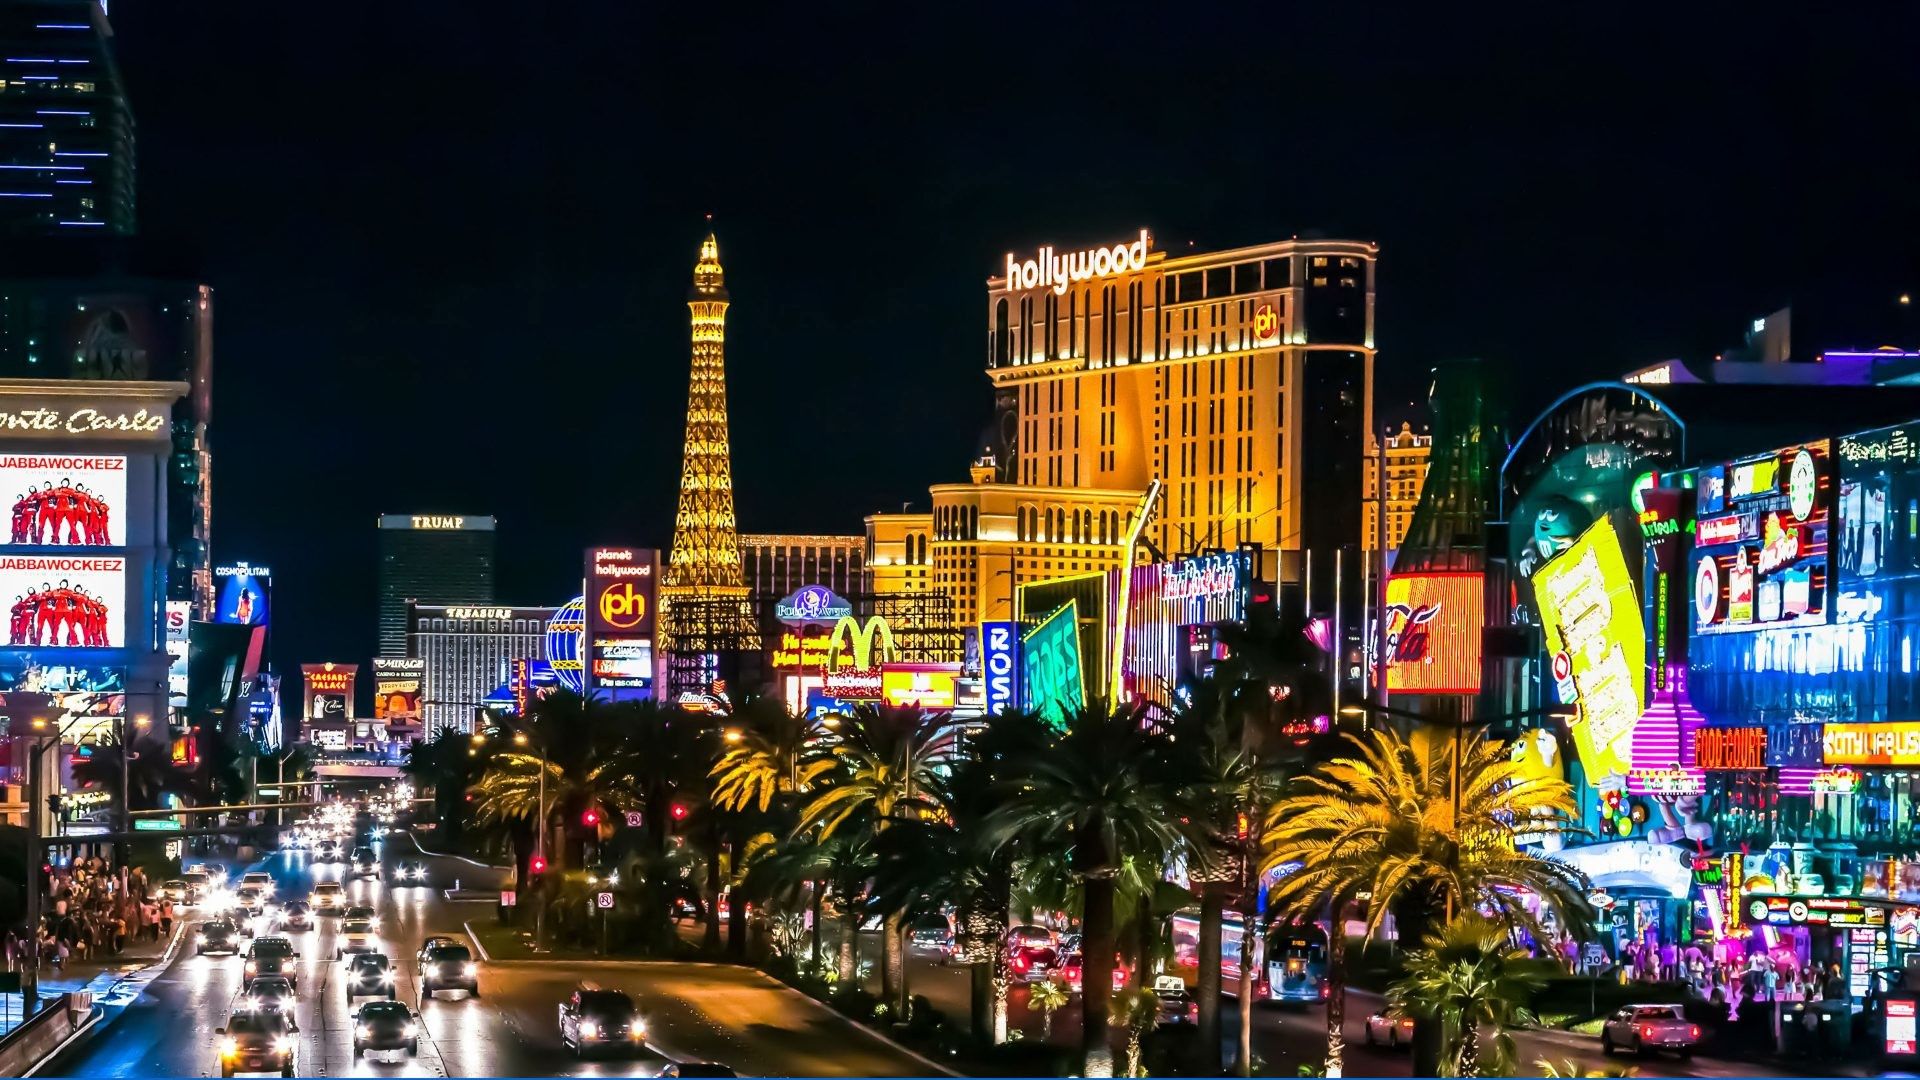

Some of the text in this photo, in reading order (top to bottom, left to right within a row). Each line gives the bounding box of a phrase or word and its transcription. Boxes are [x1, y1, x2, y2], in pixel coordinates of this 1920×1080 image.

[1006, 229, 1148, 295] hollywood
[1255, 306, 1277, 332] ph
[66, 408, 164, 433] Carlo
[0, 457, 124, 470] JABBAWOCKEEZ
[412, 516, 464, 529] TRUMP
[596, 549, 632, 562] planet
[0, 559, 123, 572] JABBAWOCKEEZ
[215, 566, 270, 576] COSMOPOLITAN
[595, 564, 651, 577] hollywood
[605, 584, 645, 621] ph
[1659, 572, 1667, 646] MARGARITAS
[446, 608, 512, 620] TREASURE
[383, 660, 424, 669] MIRAGE
[310, 673, 348, 681] CAESARS
[1695, 728, 1763, 768] FOOD COURT
[1586, 956, 1600, 964] 30
